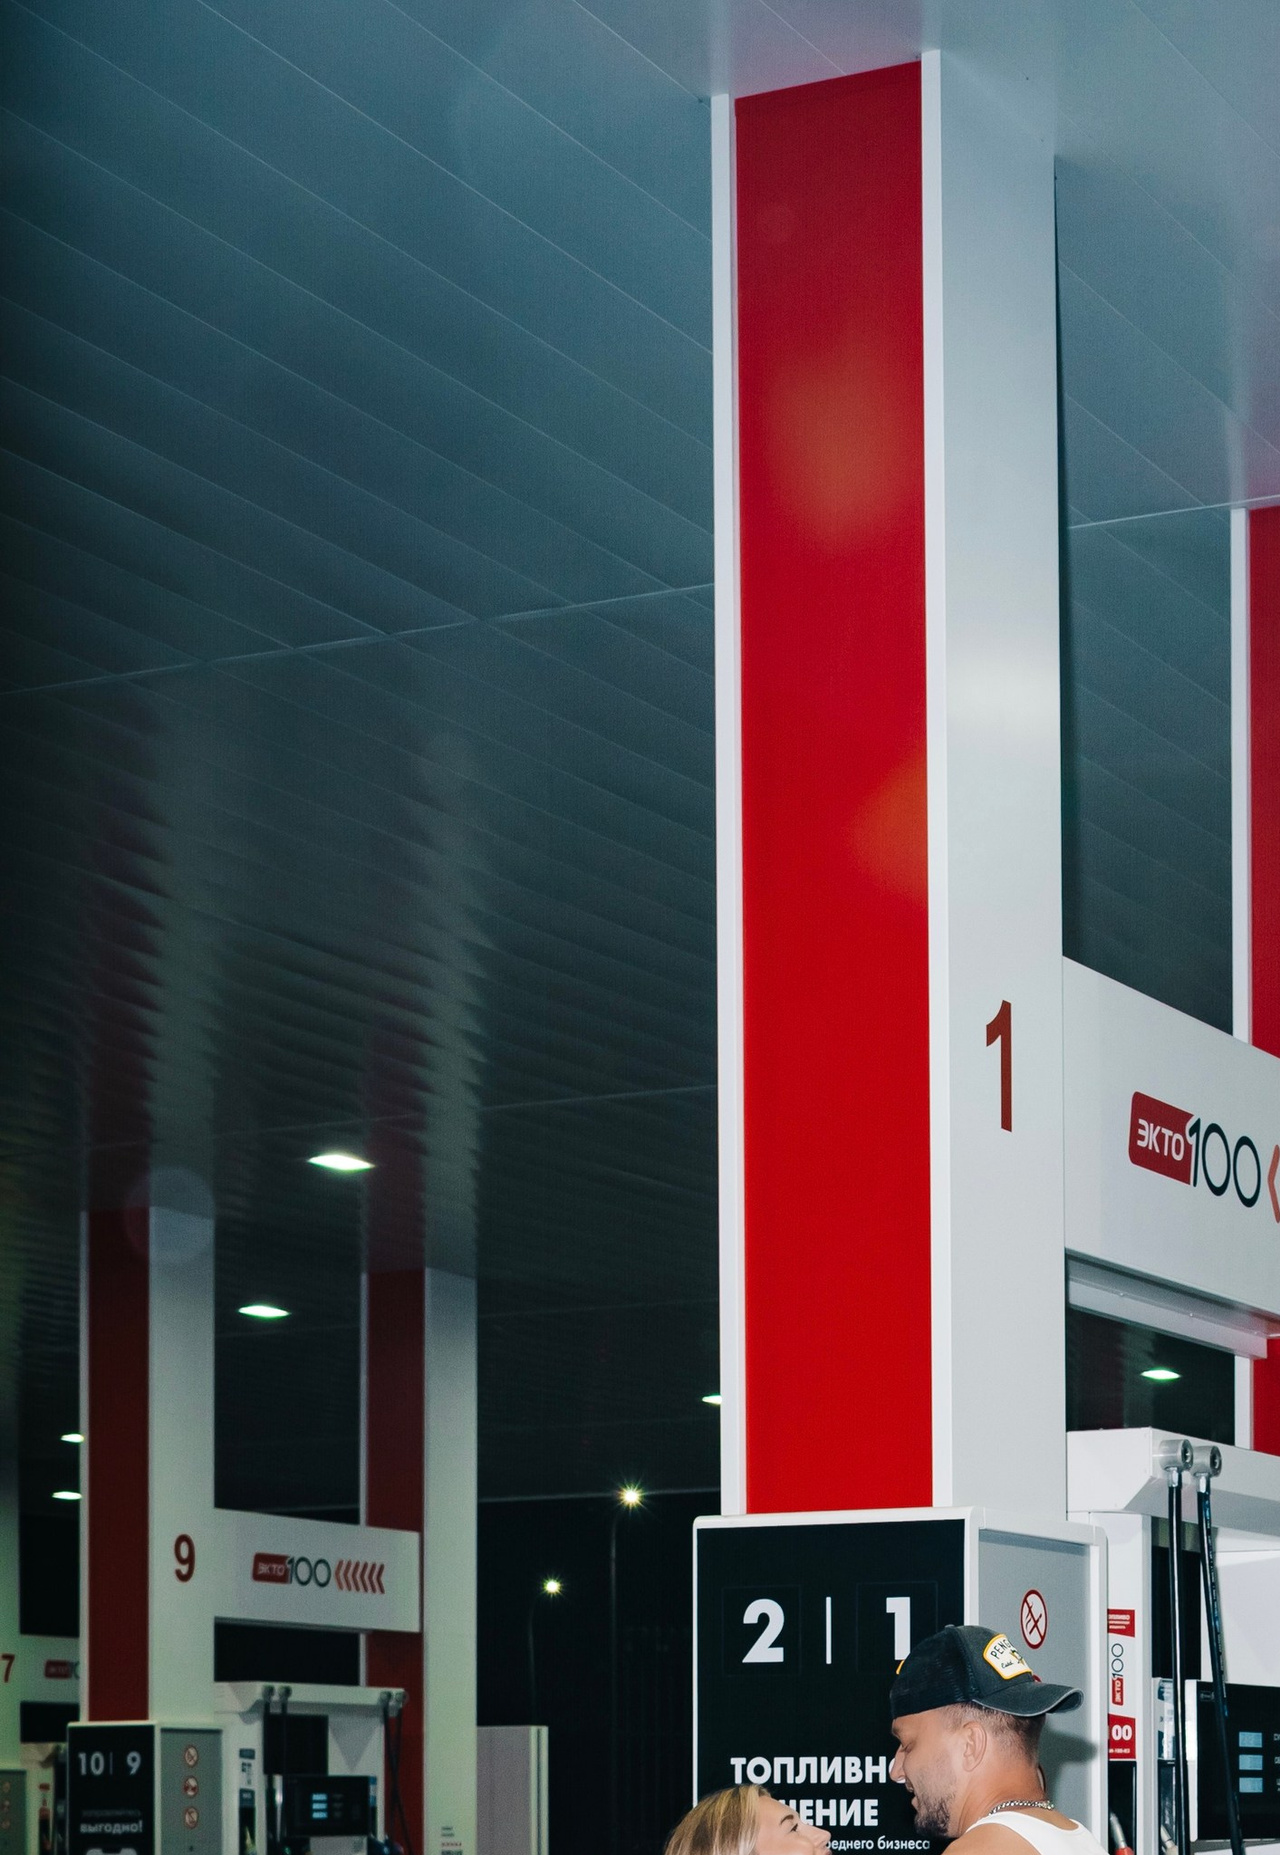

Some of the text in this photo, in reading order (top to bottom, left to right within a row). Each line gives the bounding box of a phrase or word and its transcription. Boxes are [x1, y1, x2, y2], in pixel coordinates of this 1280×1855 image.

[985, 999, 1013, 1134] 1
[1136, 1117, 1262, 1208] ЭКТО 100
[174, 1534, 196, 1583] 9
[286, 1556, 332, 1588] 100
[742, 1597, 911, 1664] 2 1
[1111, 1643, 1124, 1678] 100
[1108, 1724, 1133, 1741] 00
[77, 1751, 142, 1776] 10 9
